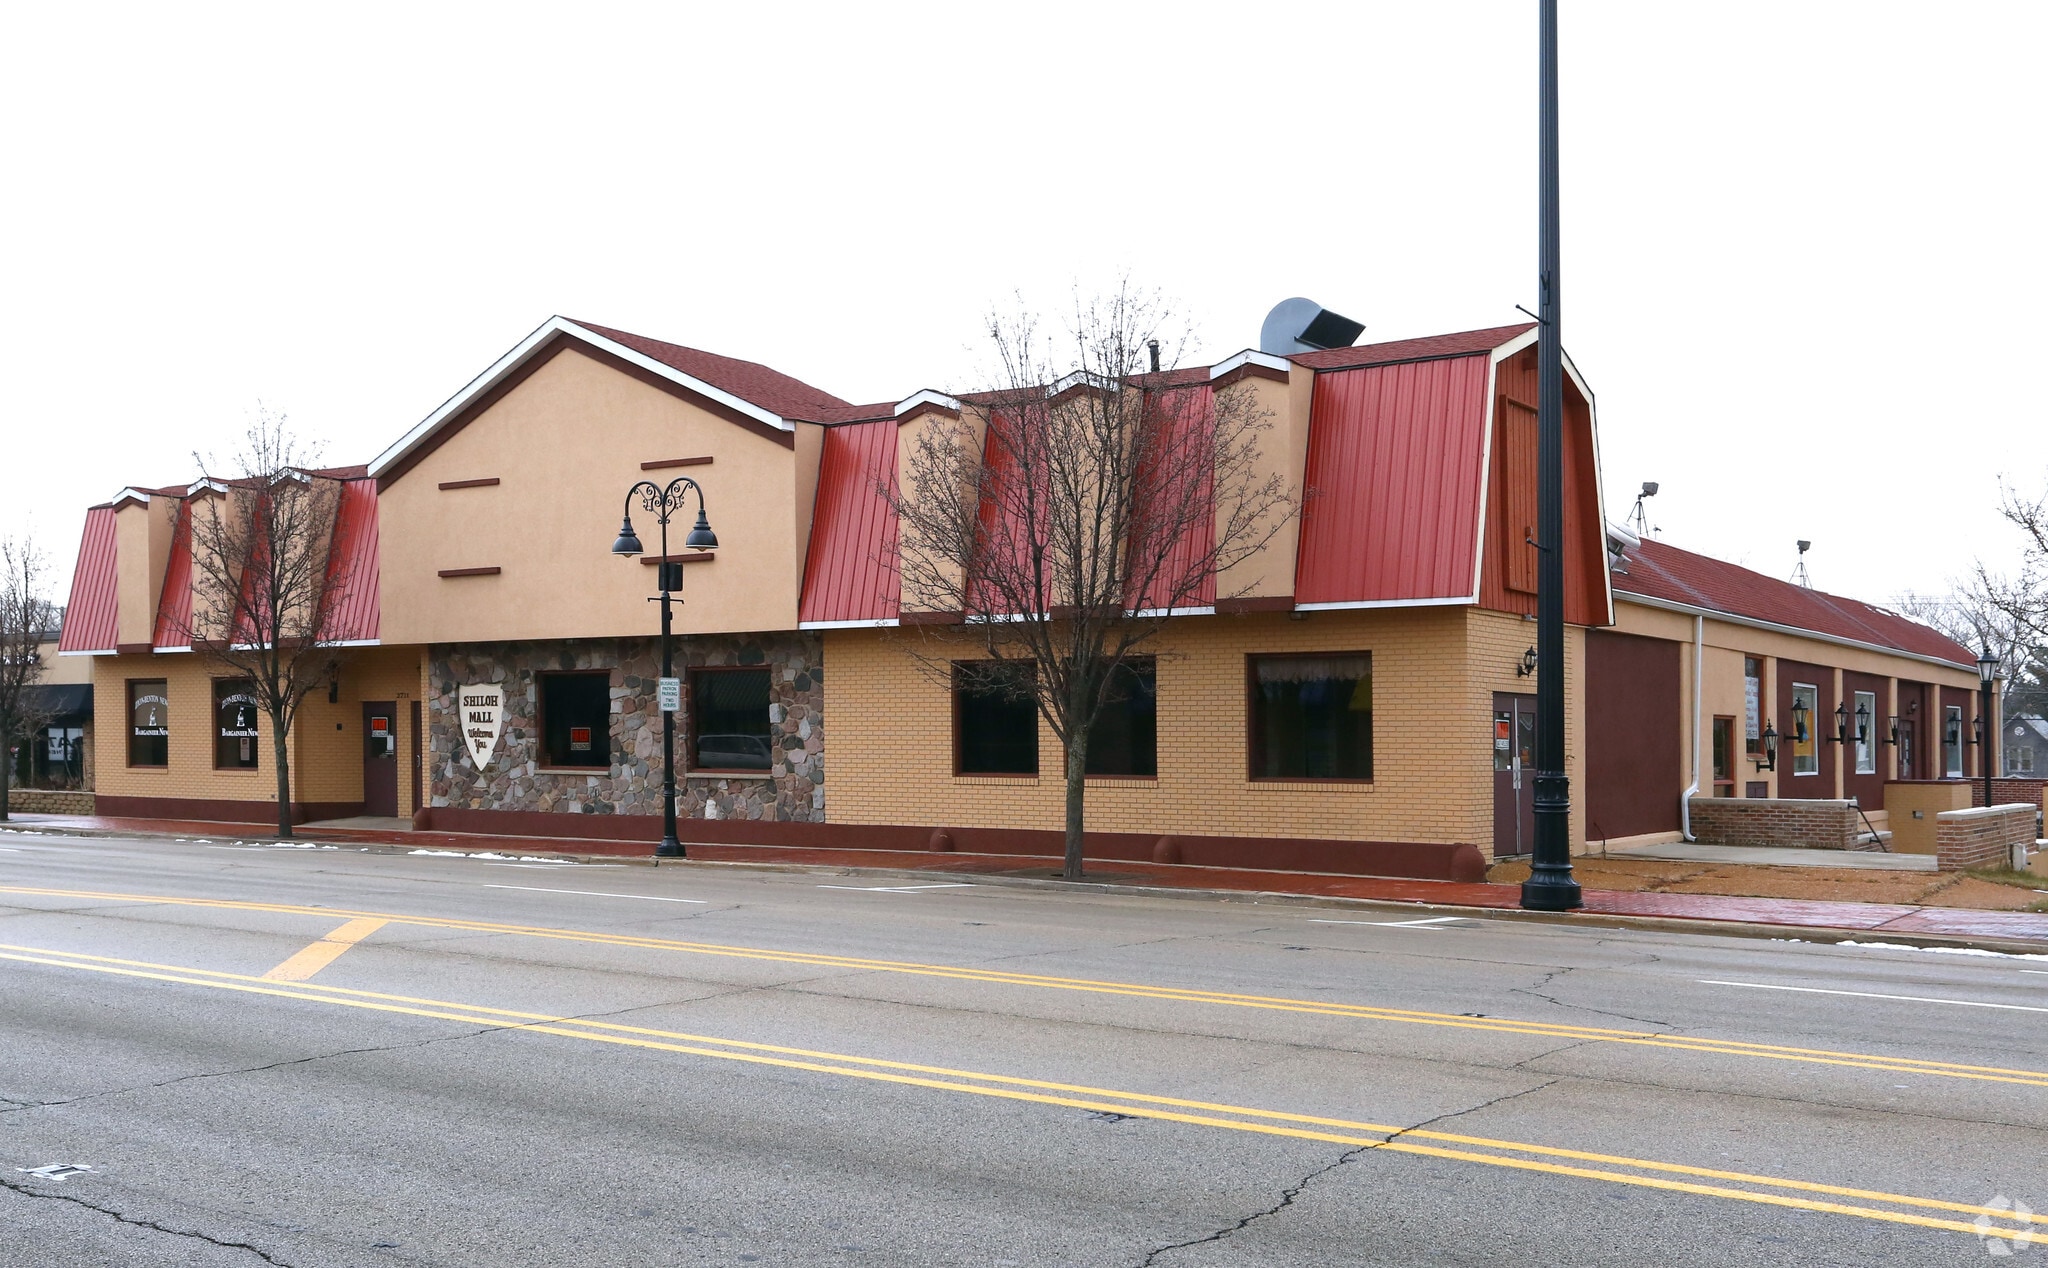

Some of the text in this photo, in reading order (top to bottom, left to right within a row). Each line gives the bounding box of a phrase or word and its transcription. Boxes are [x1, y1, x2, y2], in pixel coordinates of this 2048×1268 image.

[463, 695, 498, 706] SHILOH
[469, 711, 494, 723] MALL
[467, 728, 493, 738] Welcome
[474, 739, 487, 754] You
